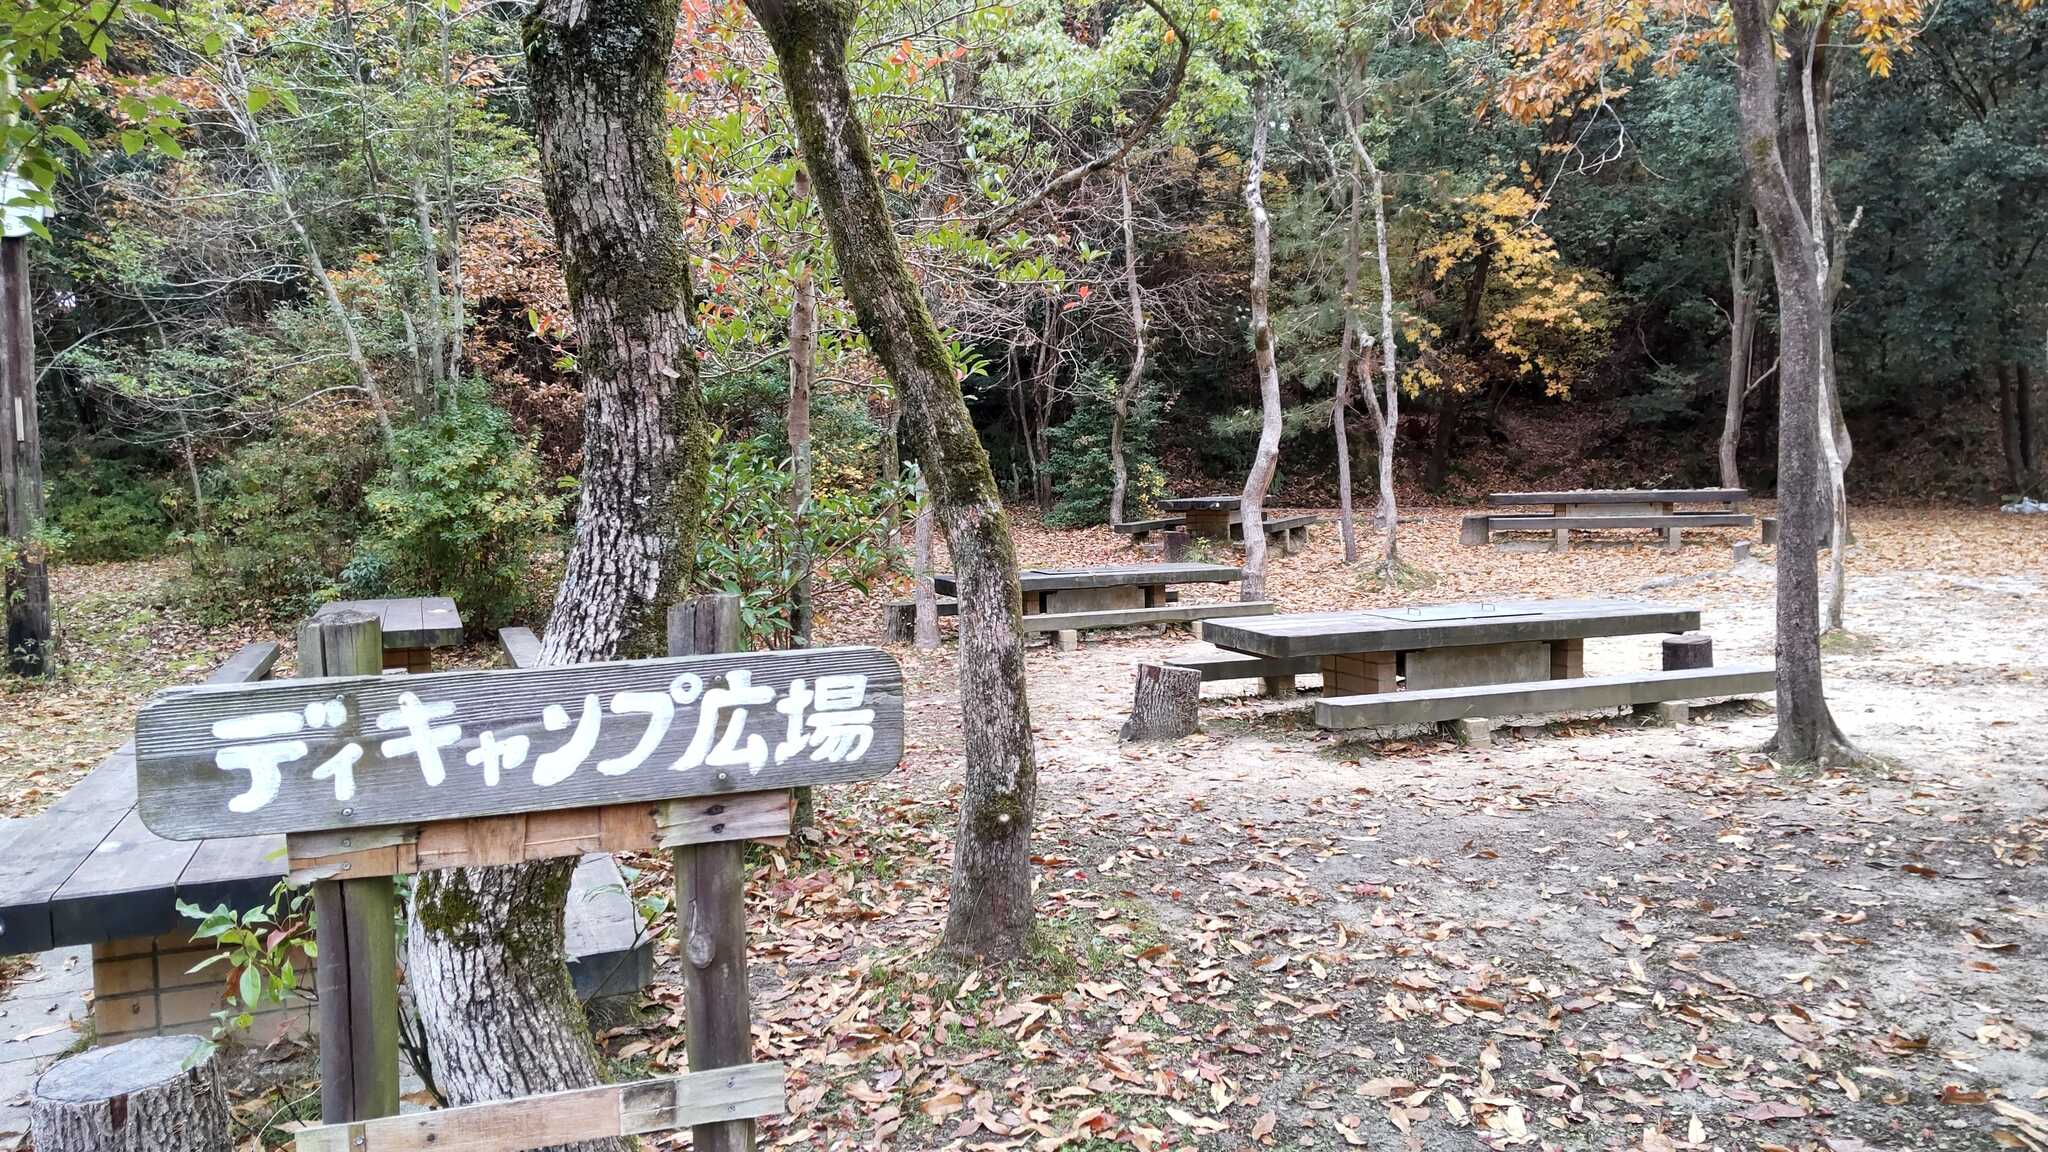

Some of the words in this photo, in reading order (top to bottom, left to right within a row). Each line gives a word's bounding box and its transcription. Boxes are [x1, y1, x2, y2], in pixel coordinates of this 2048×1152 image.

[212, 670, 876, 813] ディキャンプ広場
